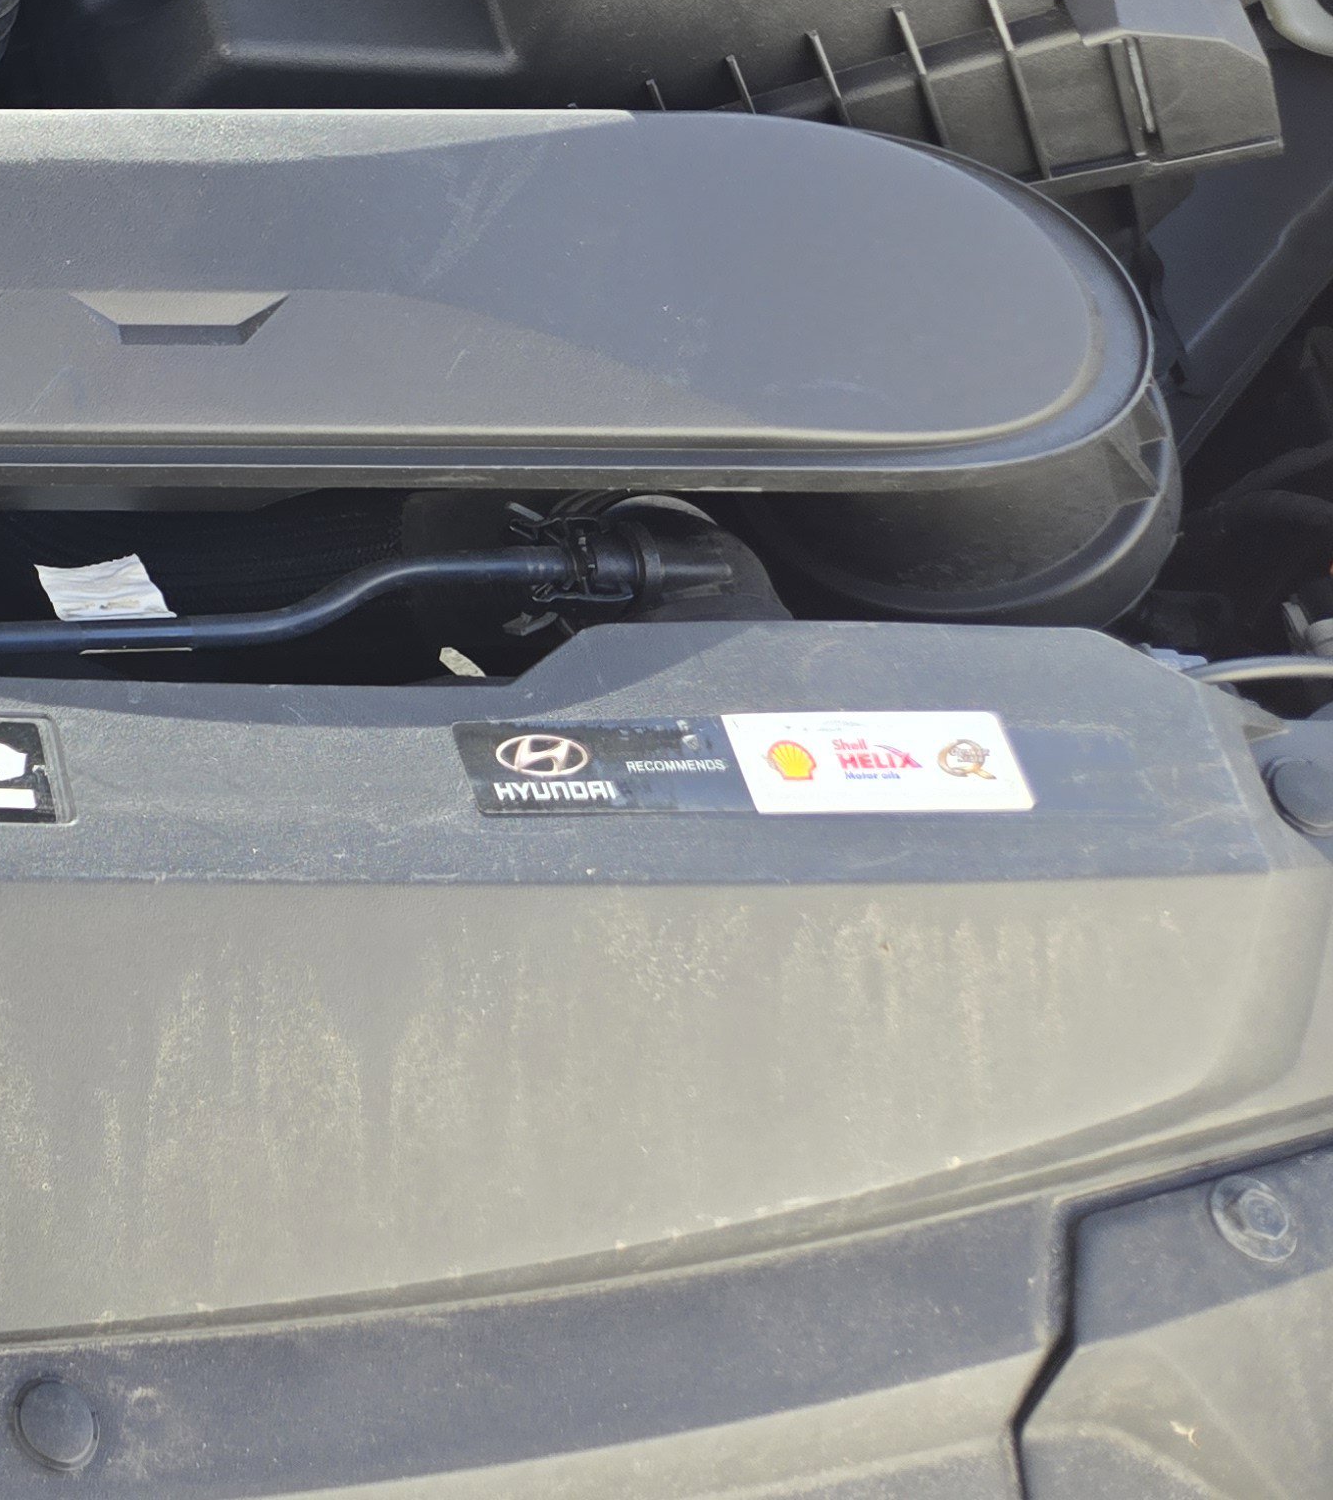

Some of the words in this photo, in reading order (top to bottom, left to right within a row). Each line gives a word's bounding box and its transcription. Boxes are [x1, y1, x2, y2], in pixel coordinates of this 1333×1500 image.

[832, 738, 867, 751] Shell
[836, 753, 922, 770] HELIX
[493, 780, 617, 801] HYUNDAI
[625, 759, 729, 774] RECOMMENDS
[844, 771, 878, 781] Motor
[881, 771, 902, 780] oils
